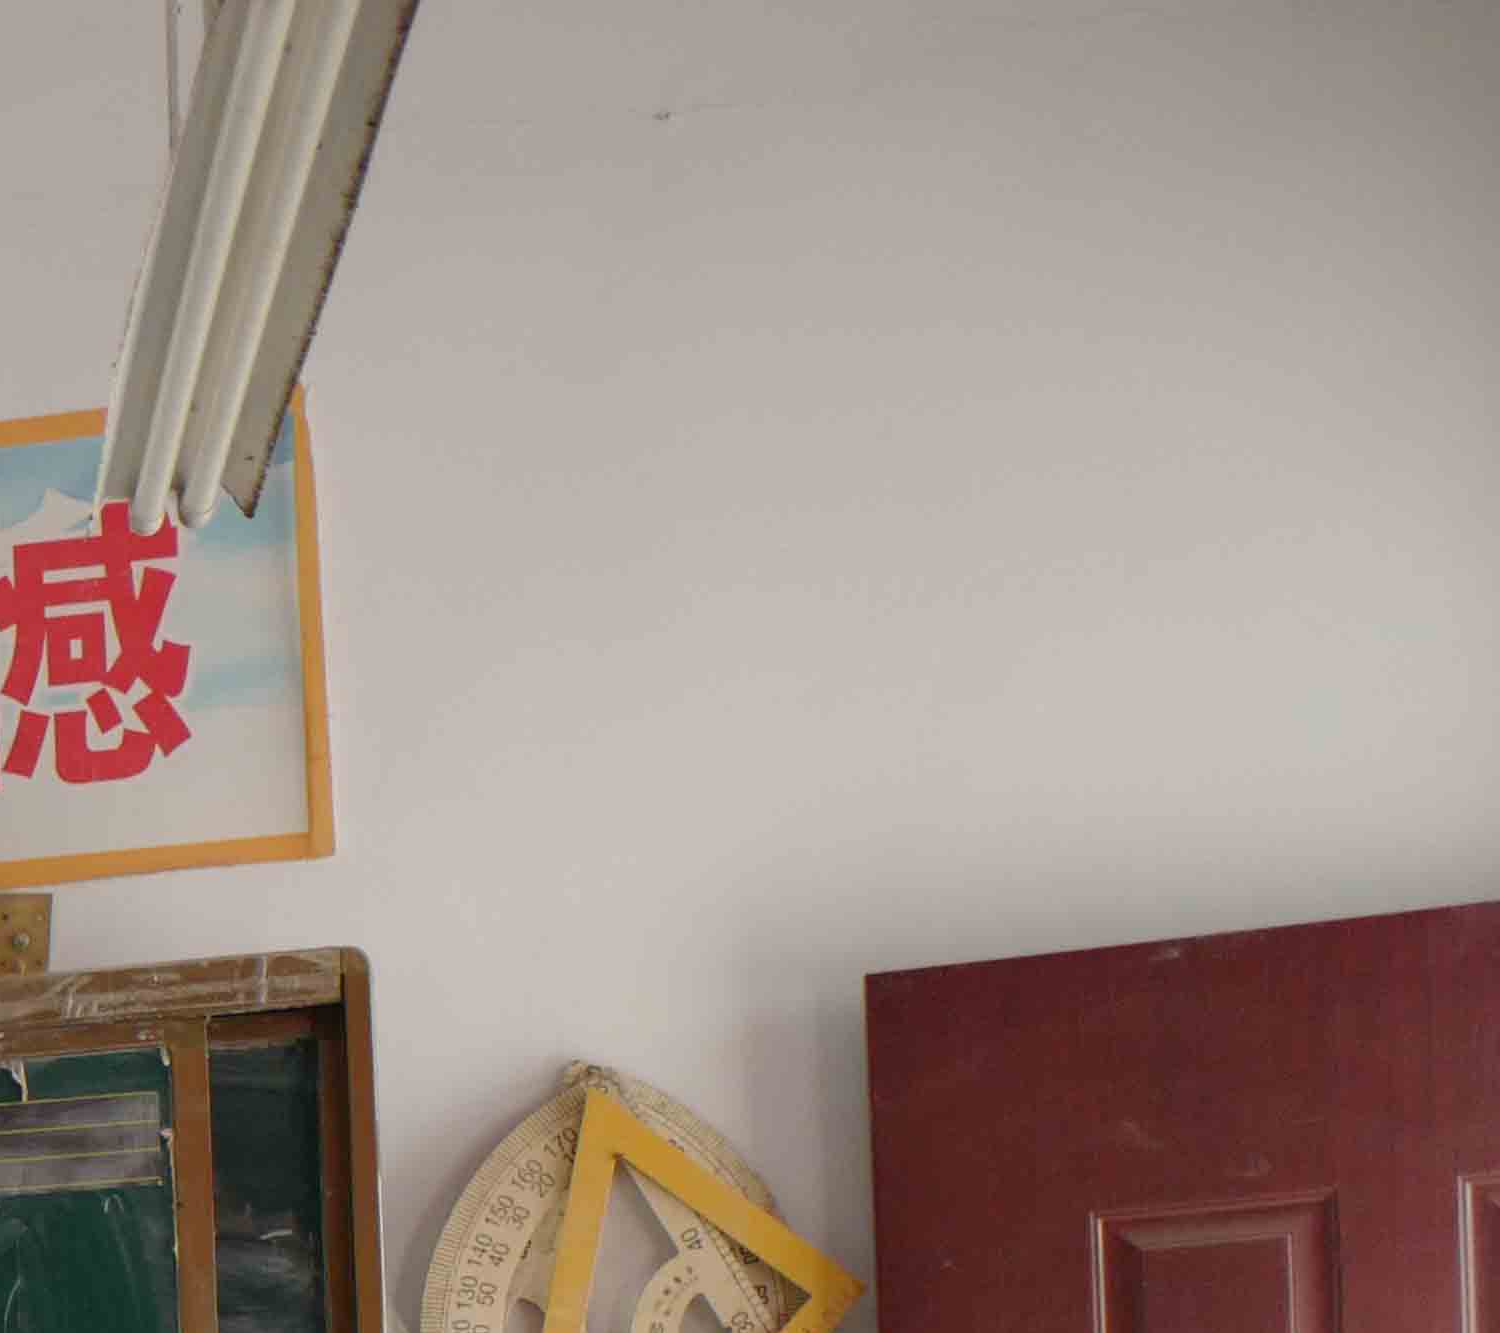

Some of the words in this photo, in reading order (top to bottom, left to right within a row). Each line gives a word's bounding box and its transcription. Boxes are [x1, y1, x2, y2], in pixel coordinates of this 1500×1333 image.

[511, 1159, 544, 1191] 160
[485, 1195, 514, 1228] 150
[506, 1205, 531, 1231] 30
[468, 1233, 493, 1267] 140
[489, 1243, 510, 1268] 40
[457, 1275, 479, 1309] 130
[476, 1281, 498, 1307] 50
